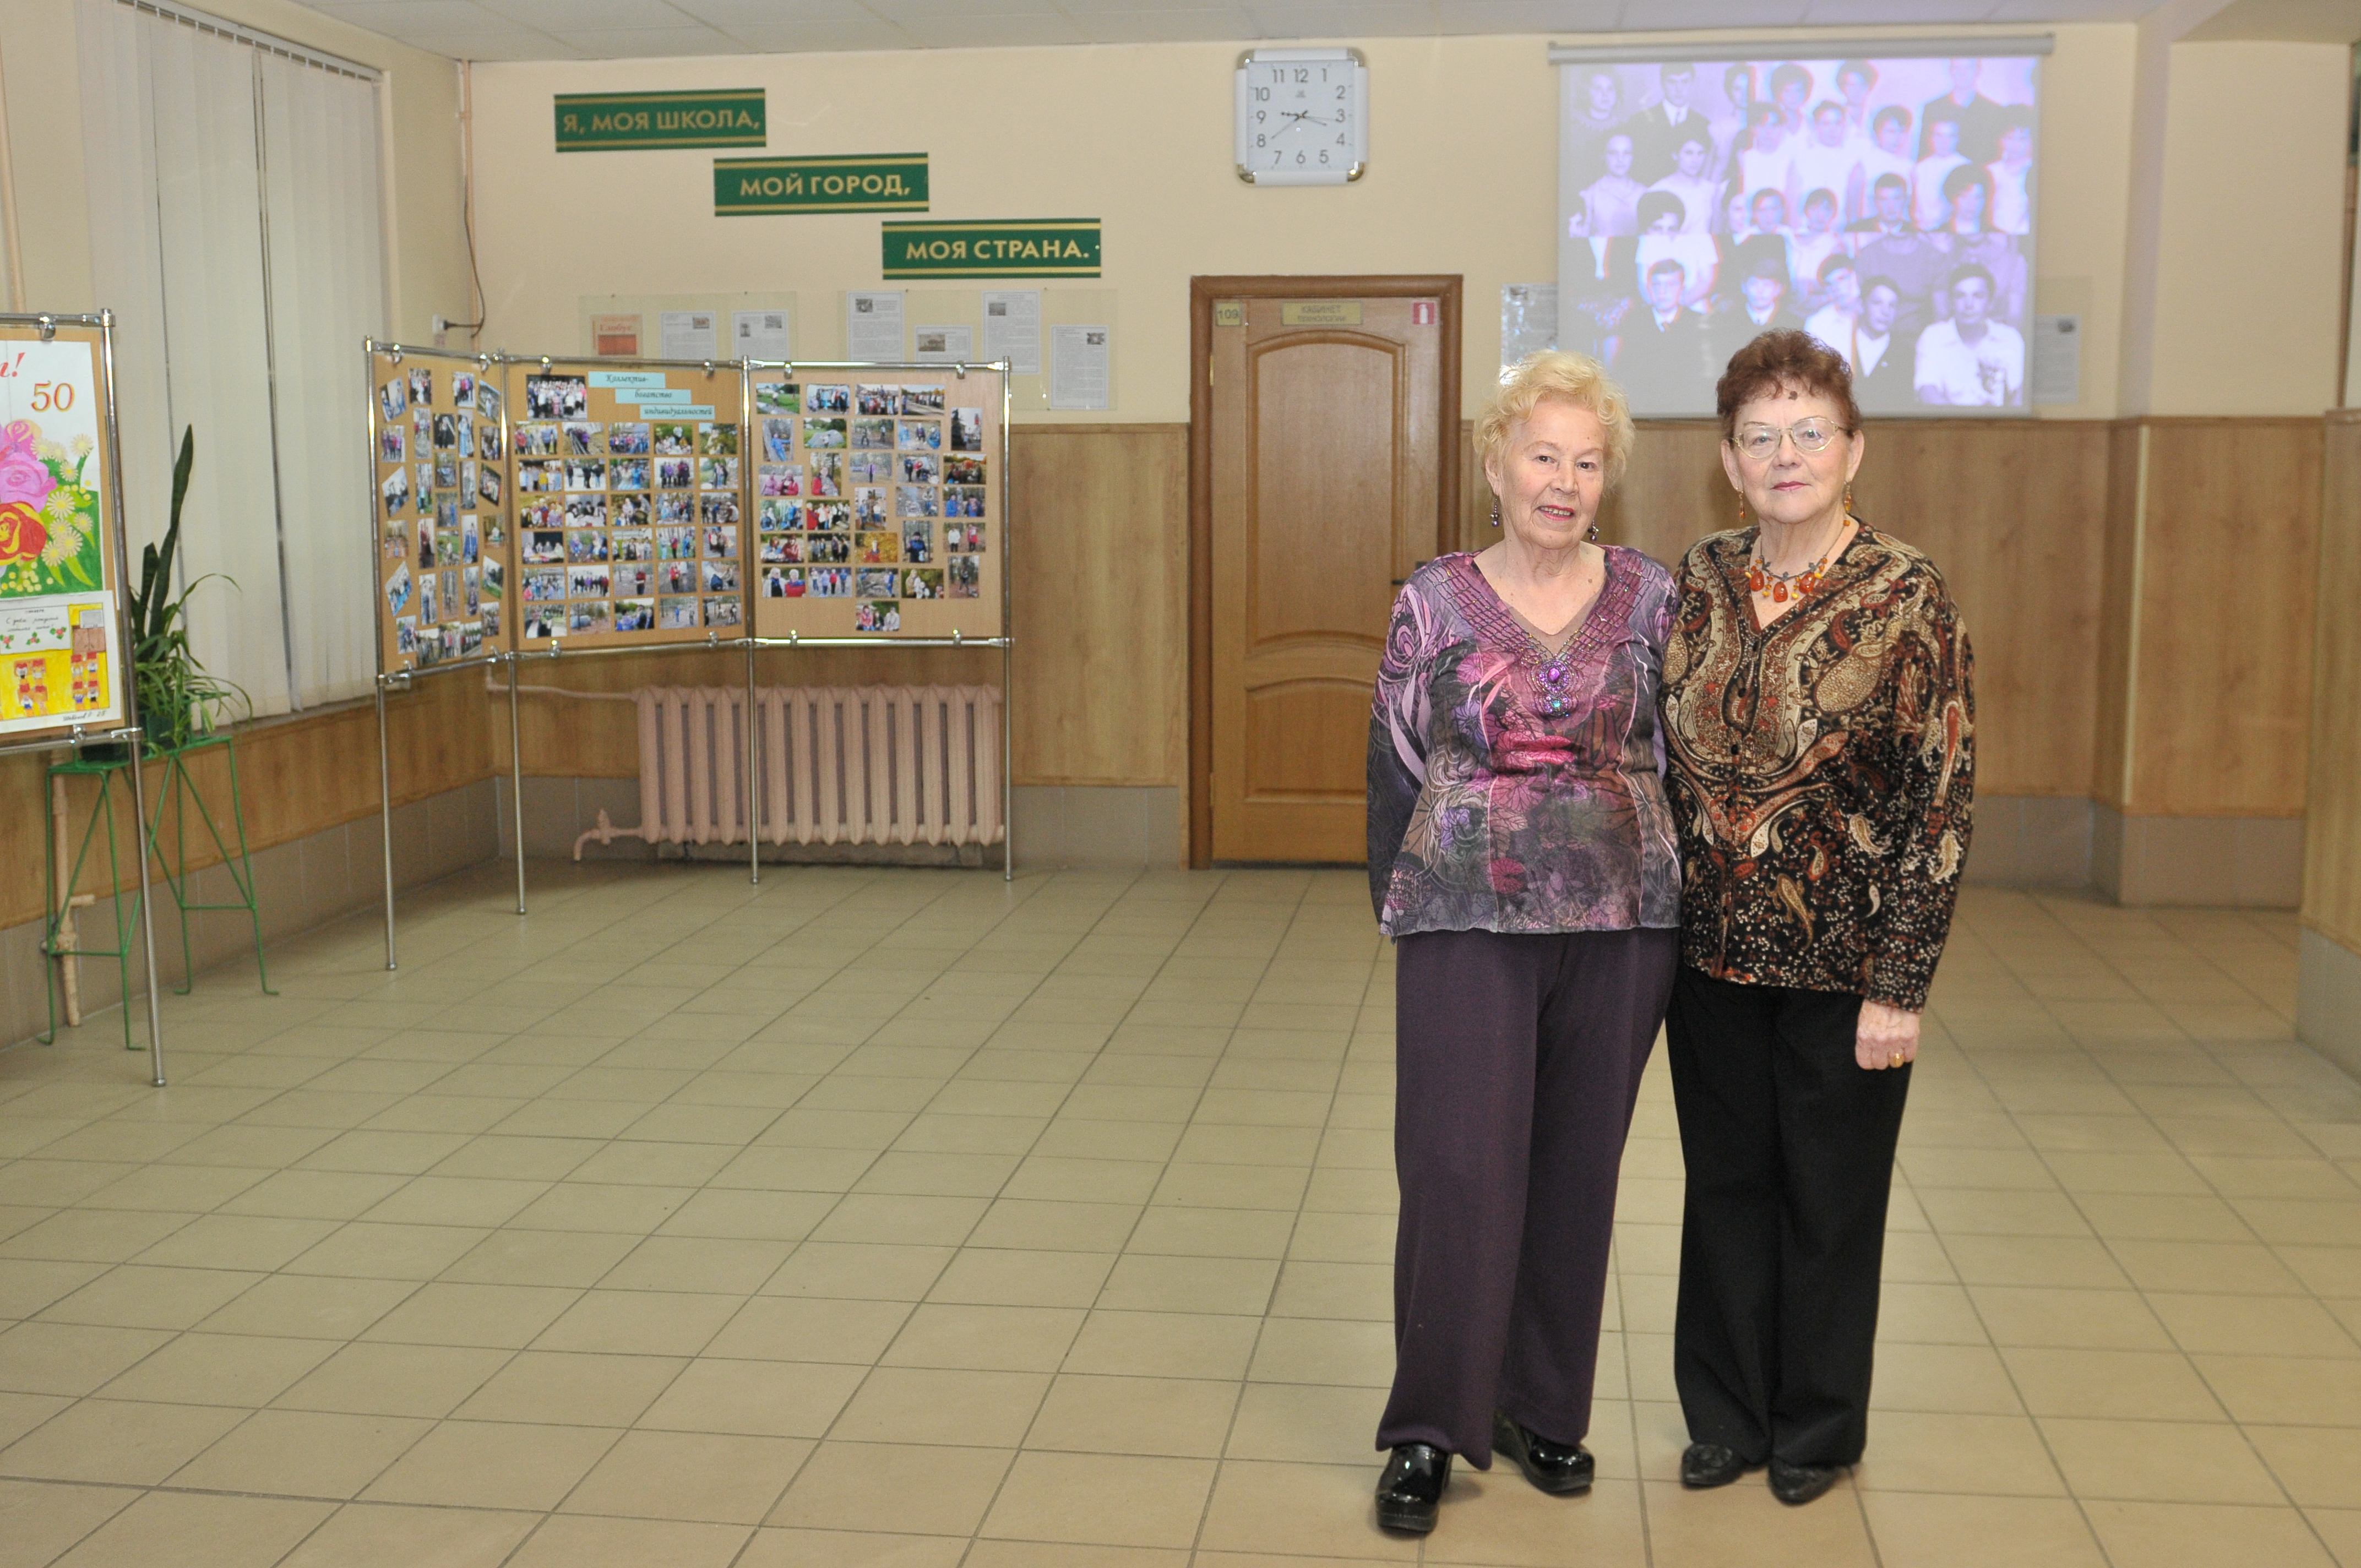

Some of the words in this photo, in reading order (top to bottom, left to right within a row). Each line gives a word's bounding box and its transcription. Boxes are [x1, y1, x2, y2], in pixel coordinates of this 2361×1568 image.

[1272, 69, 1285, 83] 11
[1293, 69, 1308, 83] 12
[1321, 68, 1327, 82] 1
[1255, 87, 1270, 101] 10
[1336, 85, 1346, 100] 2
[563, 114, 586, 134] Я,
[591, 112, 649, 132] МОЯ
[656, 109, 760, 130] ШКОЛА,
[1256, 110, 1266, 124] 9
[1336, 108, 1346, 123] 3
[1256, 133, 1266, 148] 8
[1336, 132, 1345, 145] 4
[1274, 150, 1282, 164] 7
[1296, 149, 1306, 164] 6
[1319, 149, 1329, 163] 5
[740, 172, 803, 196] МОЙ
[810, 174, 911, 196] ГОРОД,
[906, 241, 966, 259] МОЯ
[973, 239, 1090, 259] СТРАНА.
[1218, 309, 1239, 319] 109
[31, 380, 75, 412] 50
